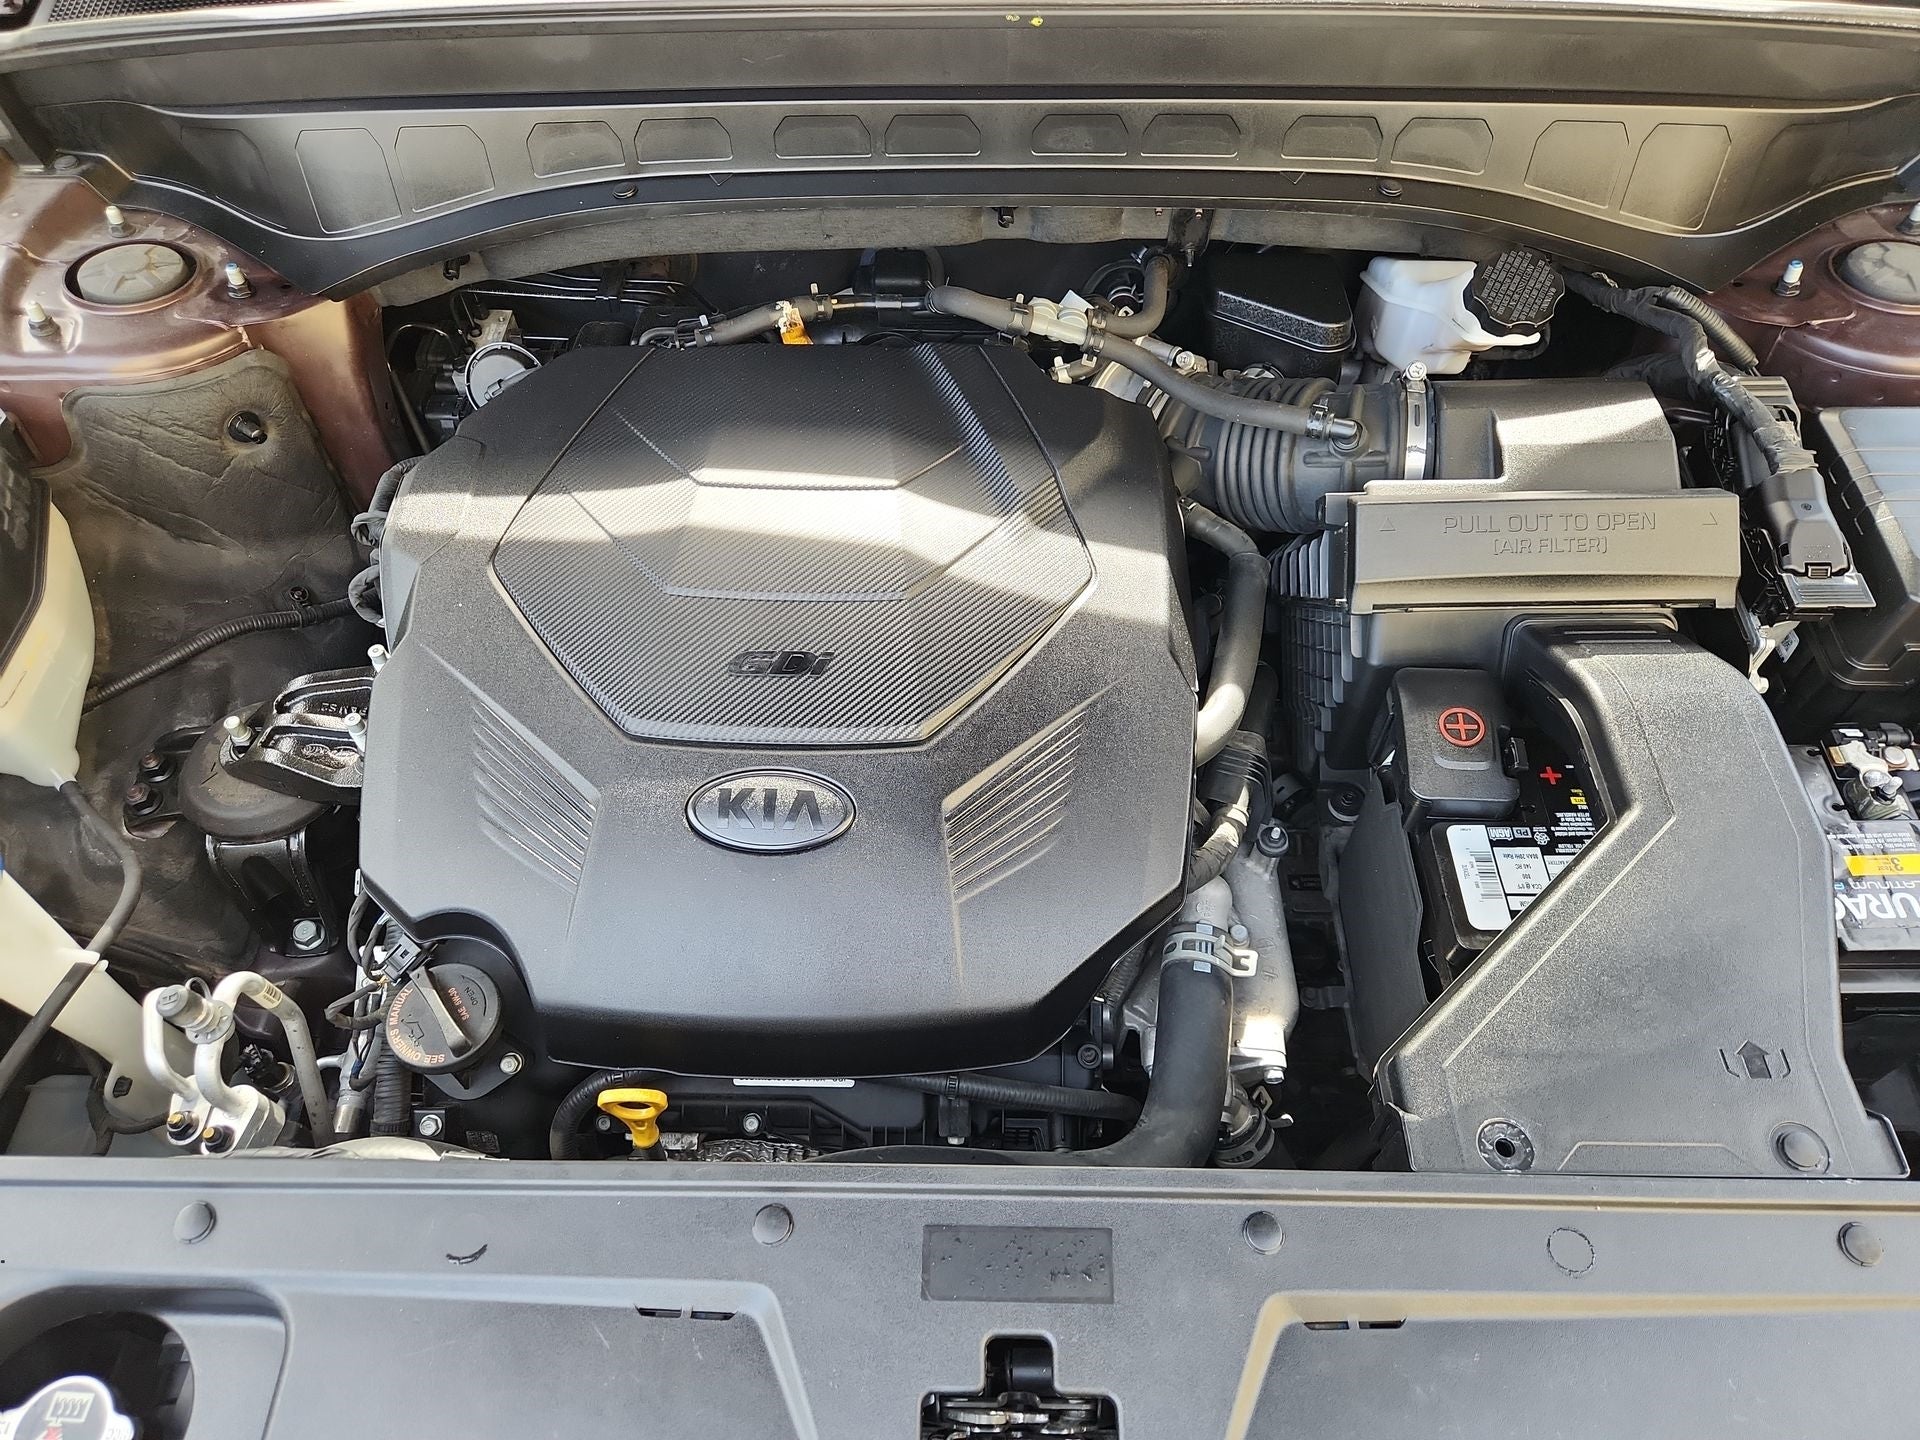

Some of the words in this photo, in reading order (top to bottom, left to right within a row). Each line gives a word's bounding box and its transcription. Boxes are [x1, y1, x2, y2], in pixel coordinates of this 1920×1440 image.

[1443, 514, 1500, 534] PULL
[1508, 513, 1553, 533] OUT
[1559, 513, 1589, 532] TO
[1596, 512, 1656, 531] OPEN
[716, 787, 826, 832] KIA
[1891, 857, 1904, 872] 3
[1834, 892, 1920, 920] URA
[389, 988, 414, 1026] MANUAL
[464, 986, 478, 1006] OPEN
[457, 1006, 470, 1021] SAE
[389, 1028, 421, 1061] OWNER'S
[424, 1054, 446, 1064] SEE
